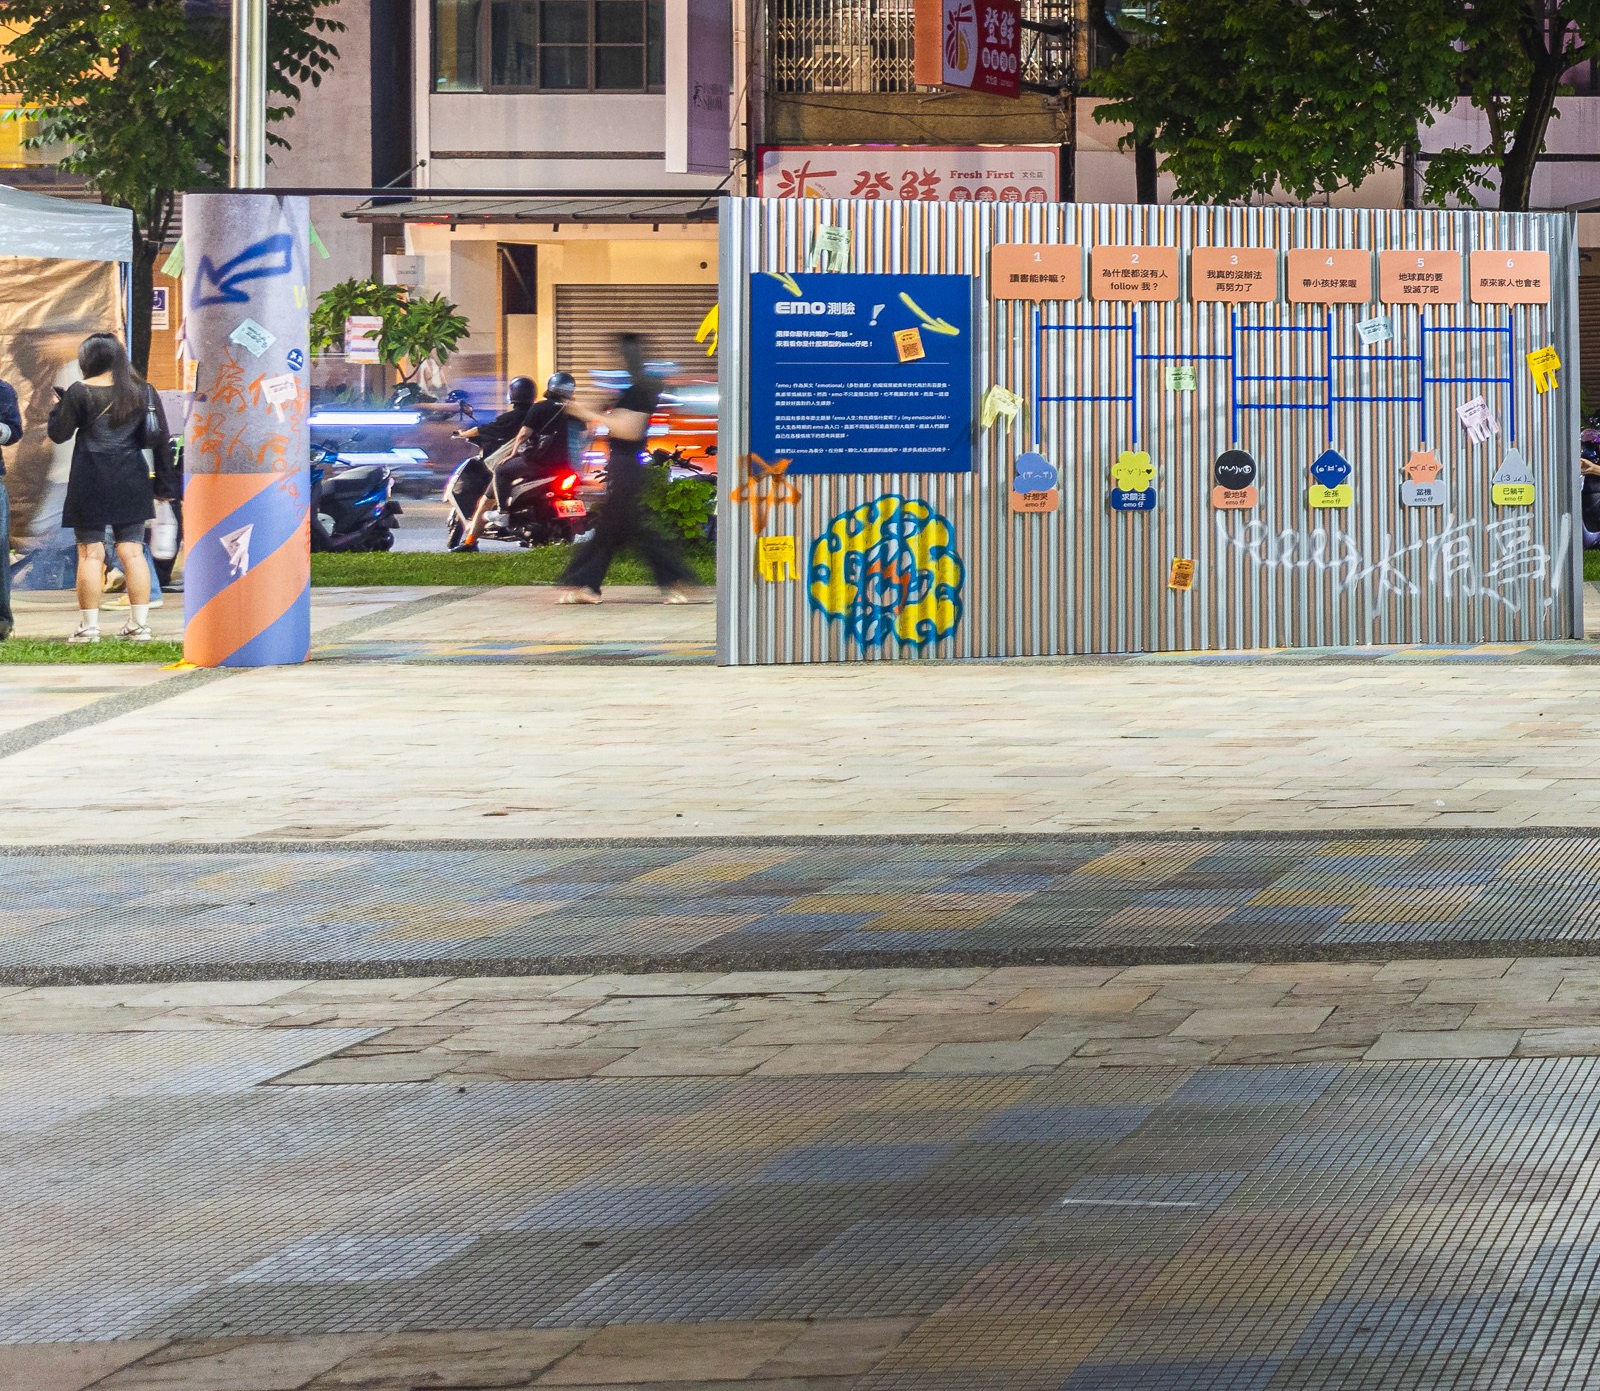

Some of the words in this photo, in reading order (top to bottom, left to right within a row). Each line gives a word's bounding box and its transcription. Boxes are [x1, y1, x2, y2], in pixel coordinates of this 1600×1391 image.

[983, 6, 1016, 50] 登鮮
[949, 169, 983, 180] Fresh
[985, 169, 1015, 180] First
[1021, 170, 1044, 180] 文化店
[1033, 251, 1042, 262] 1
[1131, 253, 1140, 264] 2
[1230, 254, 1239, 265] 3
[1325, 256, 1334, 267] 4
[1416, 258, 1425, 268] 5
[1506, 258, 1515, 269] 6
[1102, 268, 1168, 279] 為什麼都沒有人
[1206, 269, 1263, 281] 我真的沒辦法
[1398, 272, 1444, 282] 地球真的要
[1110, 281, 1139, 291] follow
[1215, 282, 1254, 293] 再努力了
[1479, 278, 1542, 289] 原來家人也會老
